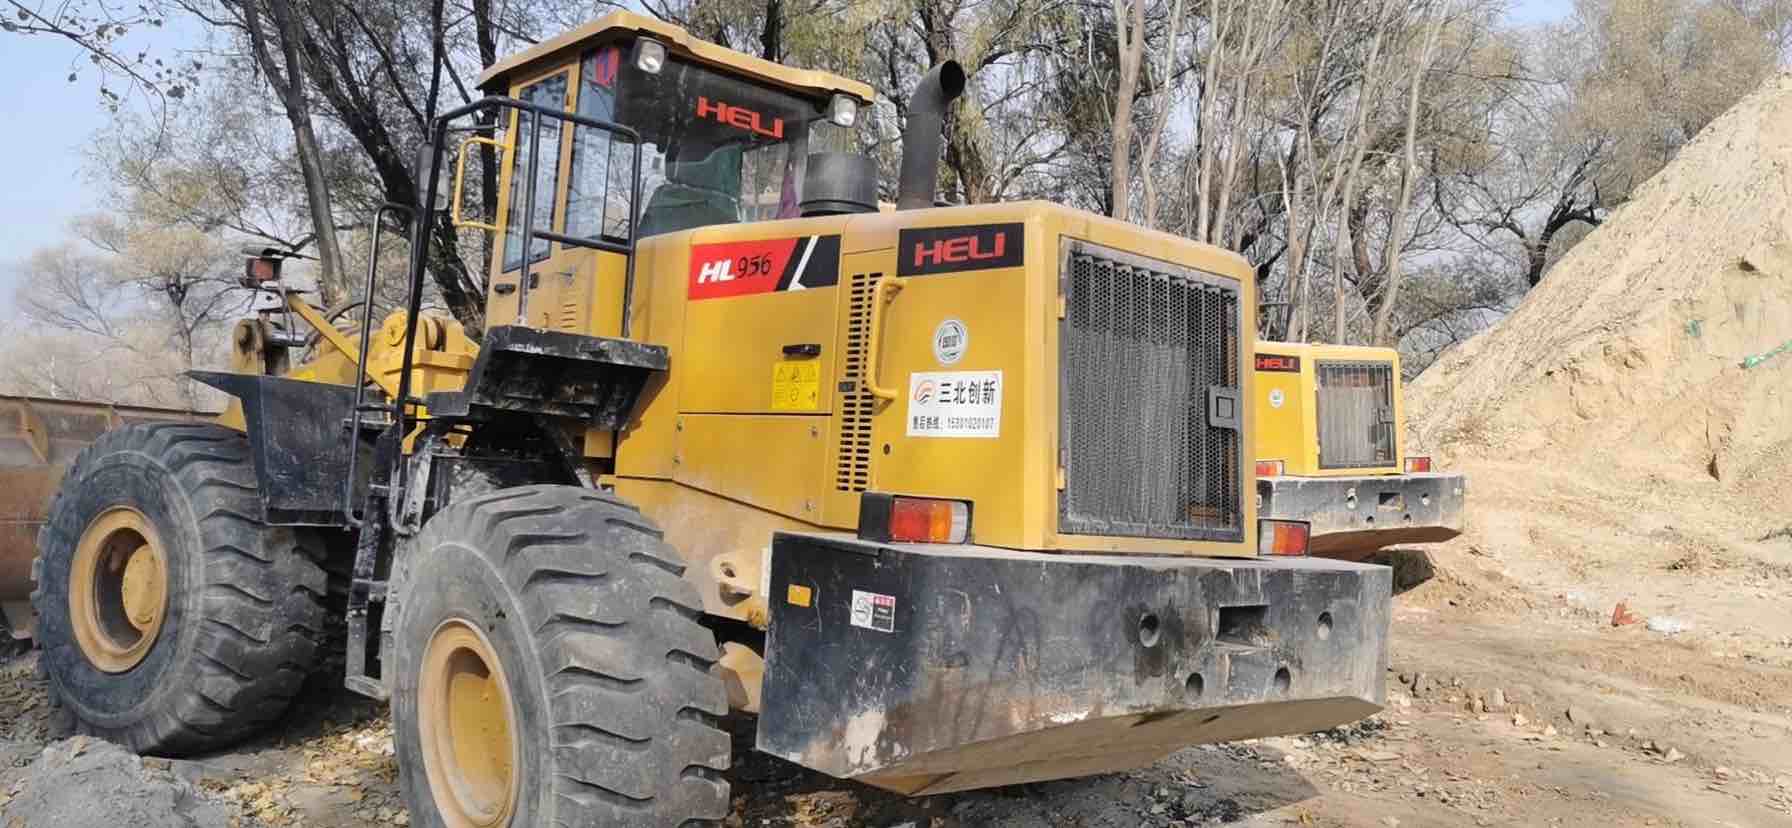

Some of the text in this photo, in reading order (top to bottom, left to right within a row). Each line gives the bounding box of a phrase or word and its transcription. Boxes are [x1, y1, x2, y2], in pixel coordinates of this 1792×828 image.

[697, 96, 784, 138] HELI
[914, 232, 1005, 267] HELI
[939, 379, 996, 405] 三北创新
